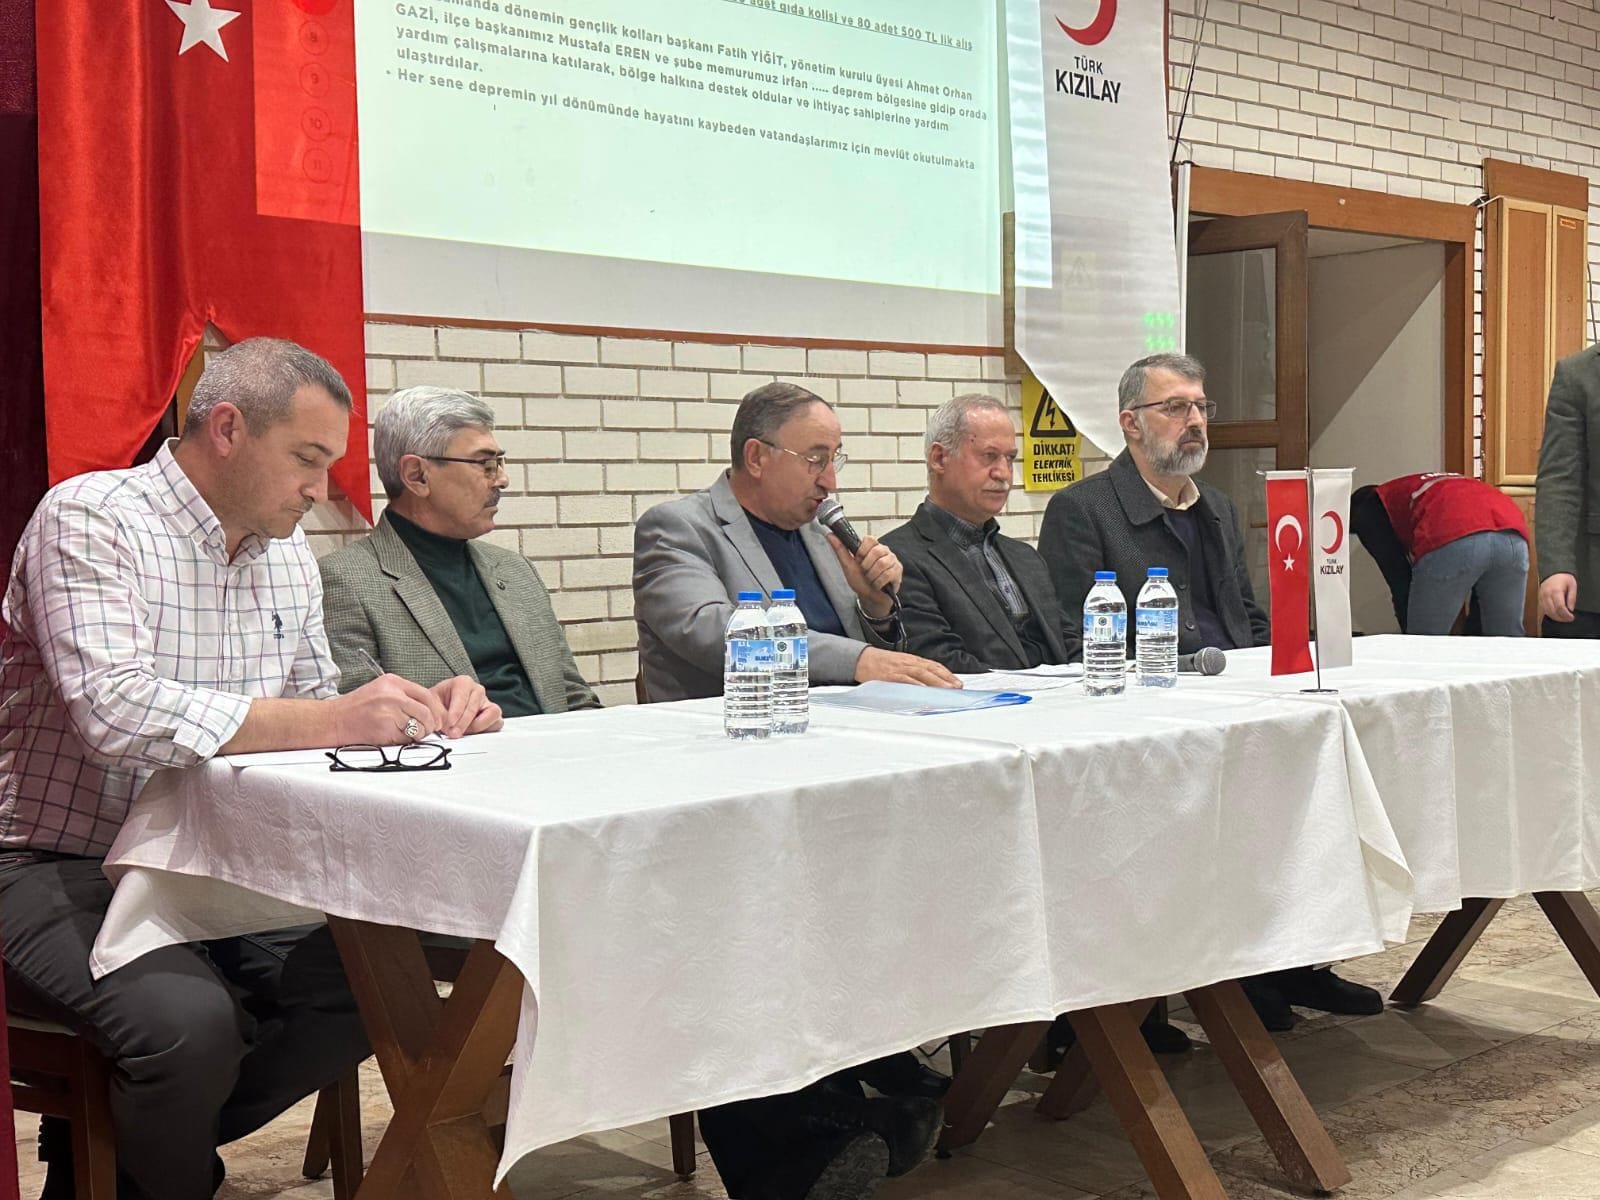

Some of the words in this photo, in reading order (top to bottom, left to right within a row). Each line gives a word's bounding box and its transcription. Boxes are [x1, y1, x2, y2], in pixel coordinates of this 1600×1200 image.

[780, 2, 804, 15] gıda
[808, 6, 838, 22] kolisi
[841, 15, 853, 26] ve
[857, 17, 871, 29] 80
[874, 22, 898, 35] adet
[901, 26, 921, 39] 500
[925, 31, 937, 43] TL
[395, 3, 438, 24] GAZİ,
[444, 11, 470, 28] ilçe
[475, 17, 554, 43] başkanımız
[559, 34, 611, 54] Mustafa
[615, 44, 650, 61] EREN
[655, 53, 669, 64] ve
[673, 56, 702, 71] şube
[706, 62, 778, 84] memurumuz
[832, 84, 873, 101] deprem
[876, 91, 927, 110] bölgesine
[930, 102, 956, 117] gidip
[958, 109, 987, 121] orada
[397, 47, 483, 72] ulaştırdılar.
[504, 3, 564, 25] dönemin
[569, 17, 617, 35] gençlik
[622, 25, 662, 44] kolları
[666, 34, 713, 54] başkanı
[717, 43, 747, 60] Fatih
[751, 50, 787, 69] YİĞİT,
[791, 58, 836, 76] yönetim
[839, 66, 872, 83] kurulu
[876, 74, 903, 89] üyesi
[906, 79, 940, 95] Ahmet
[942, 86, 973, 101] Orhan
[1074, 55, 1103, 75] TÜRK
[396, 26, 448, 45] yardım
[453, 37, 548, 63] çalışmalarına
[552, 53, 615, 76] katılarak,
[619, 65, 656, 83] bölge
[660, 72, 704, 90] halkına
[708, 81, 748, 98] destek
[752, 90, 793, 105] oldular
[796, 97, 809, 108] ve
[813, 99, 850, 116] ihtiyaç
[853, 108, 911, 125] sahiplerine
[914, 117, 949, 132] yardım
[1055, 69, 1121, 103] KIZILAY
[398, 68, 424, 83] Her
[429, 75, 463, 90] sene
[468, 80, 536, 102] depremin
[540, 93, 557, 106] yıl
[562, 96, 639, 119] dönümünde
[644, 108, 694, 127] hayatını
[698, 117, 756, 137] kaybeden
[760, 128, 848, 151] vatandaşlarımız
[851, 141, 871, 154] için
[874, 146, 909, 161] mevlüt
[913, 151, 975, 170] okutulmakta
[1032, 470, 1075, 482] TEHLİKESİ
[1033, 457, 1072, 469] ELEKTRİK
[1320, 565, 1344, 574] KIZILAY
